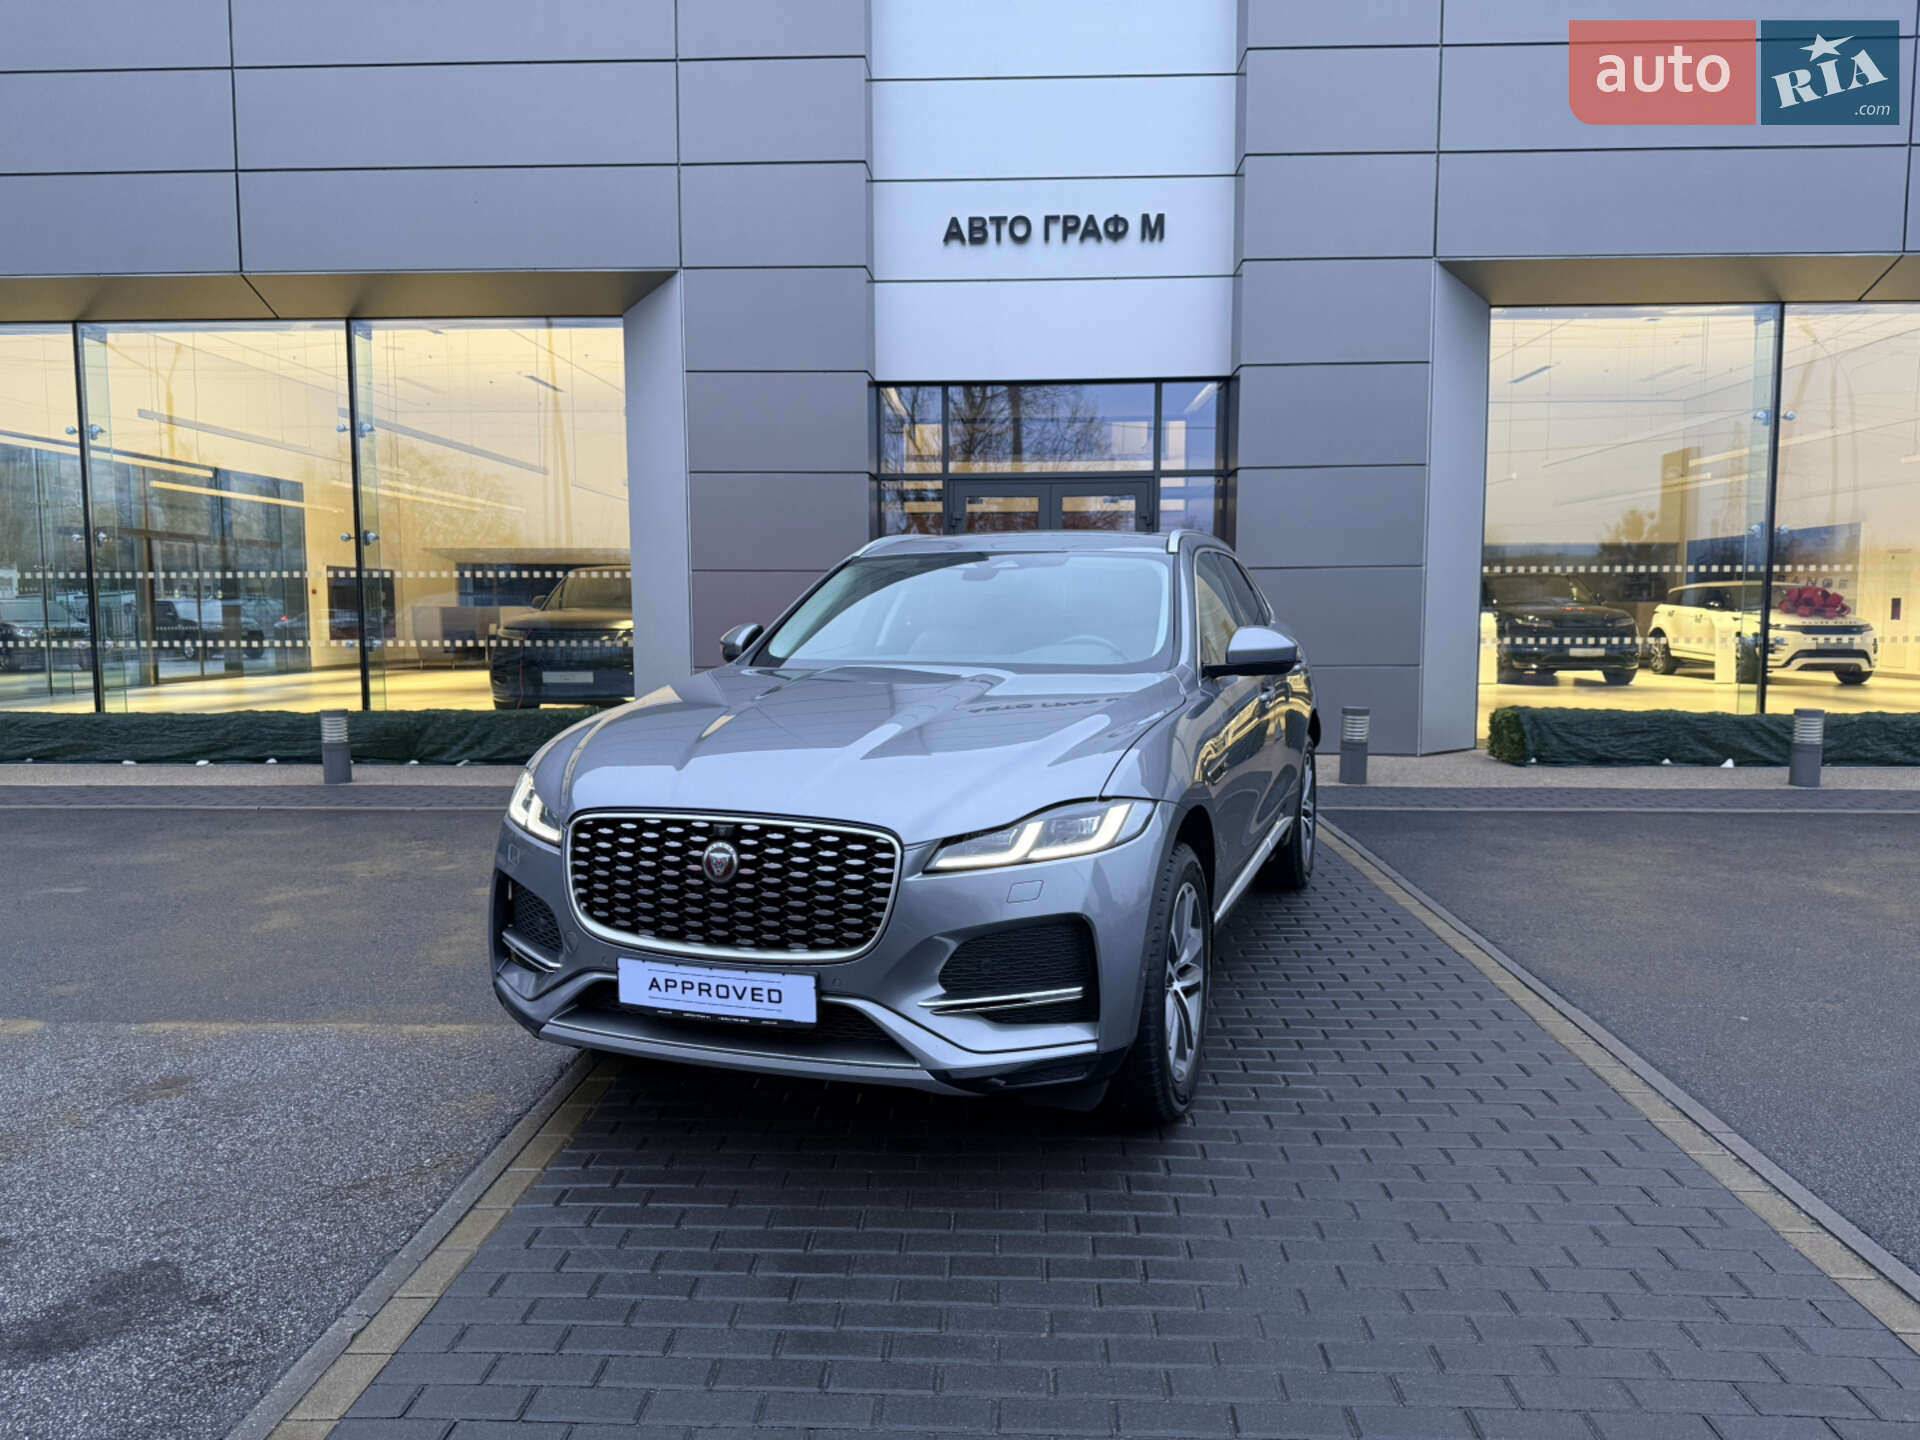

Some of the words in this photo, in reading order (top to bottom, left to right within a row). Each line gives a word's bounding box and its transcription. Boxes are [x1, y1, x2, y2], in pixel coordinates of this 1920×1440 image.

[943, 215, 1033, 246] АВТО
[1043, 213, 1130, 244] ГРАФ
[1140, 212, 1165, 243] М
[648, 977, 783, 1004] APPROVED
